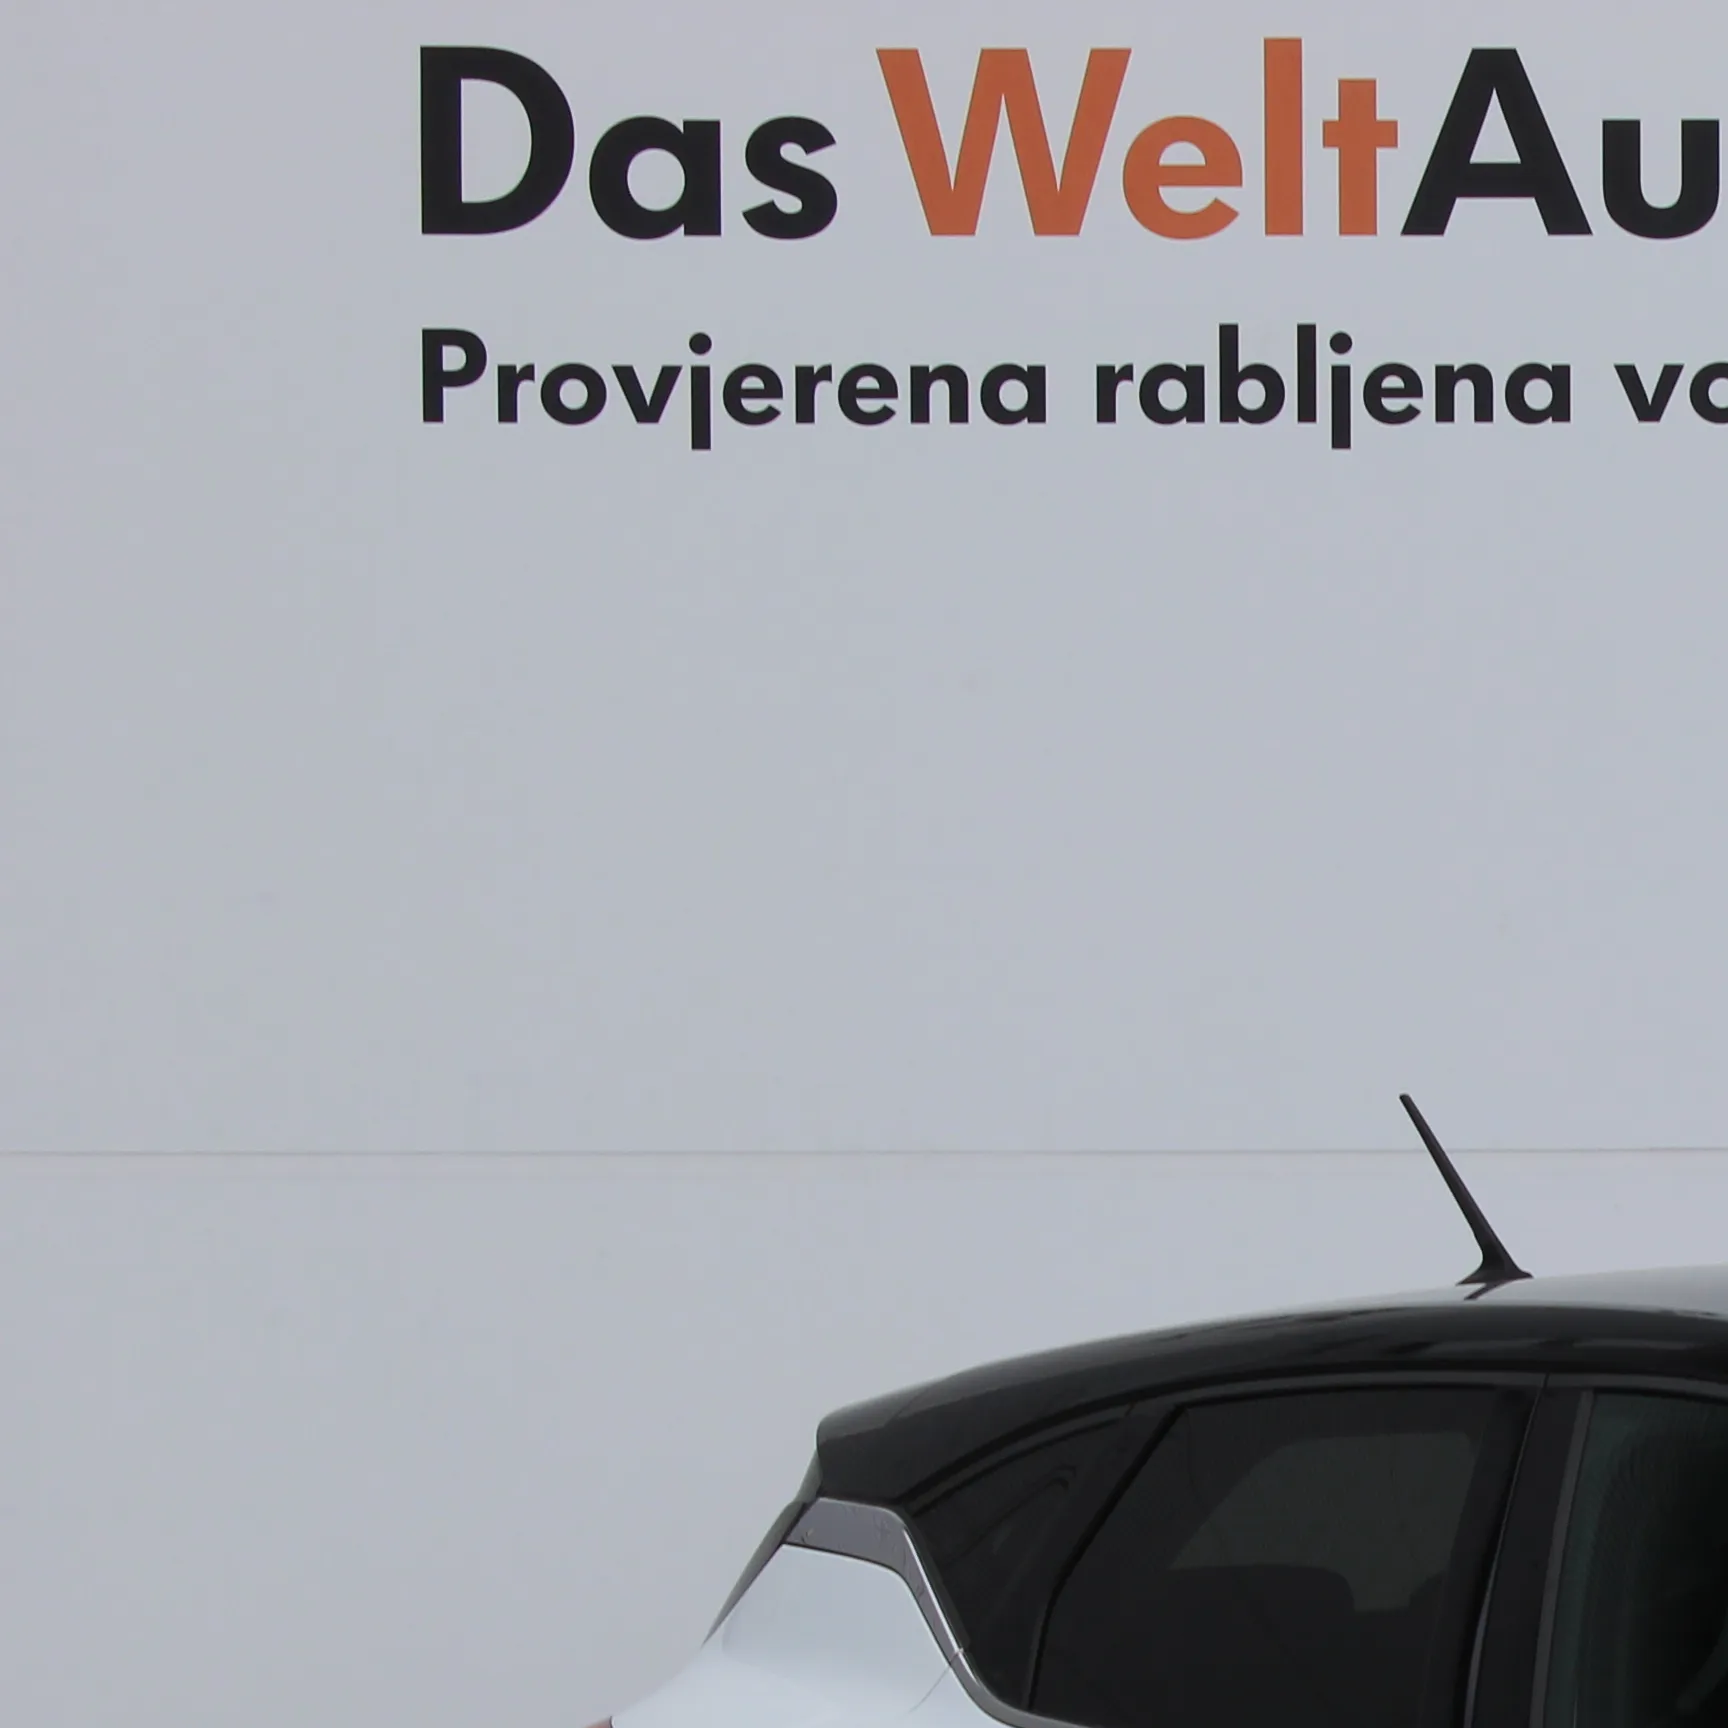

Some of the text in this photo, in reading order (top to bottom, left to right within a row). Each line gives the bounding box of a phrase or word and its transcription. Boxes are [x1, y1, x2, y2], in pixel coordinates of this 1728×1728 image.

[420, 46, 837, 240] Das
[421, 328, 1047, 451] Provjerena
[1096, 323, 1571, 450] rabljena
